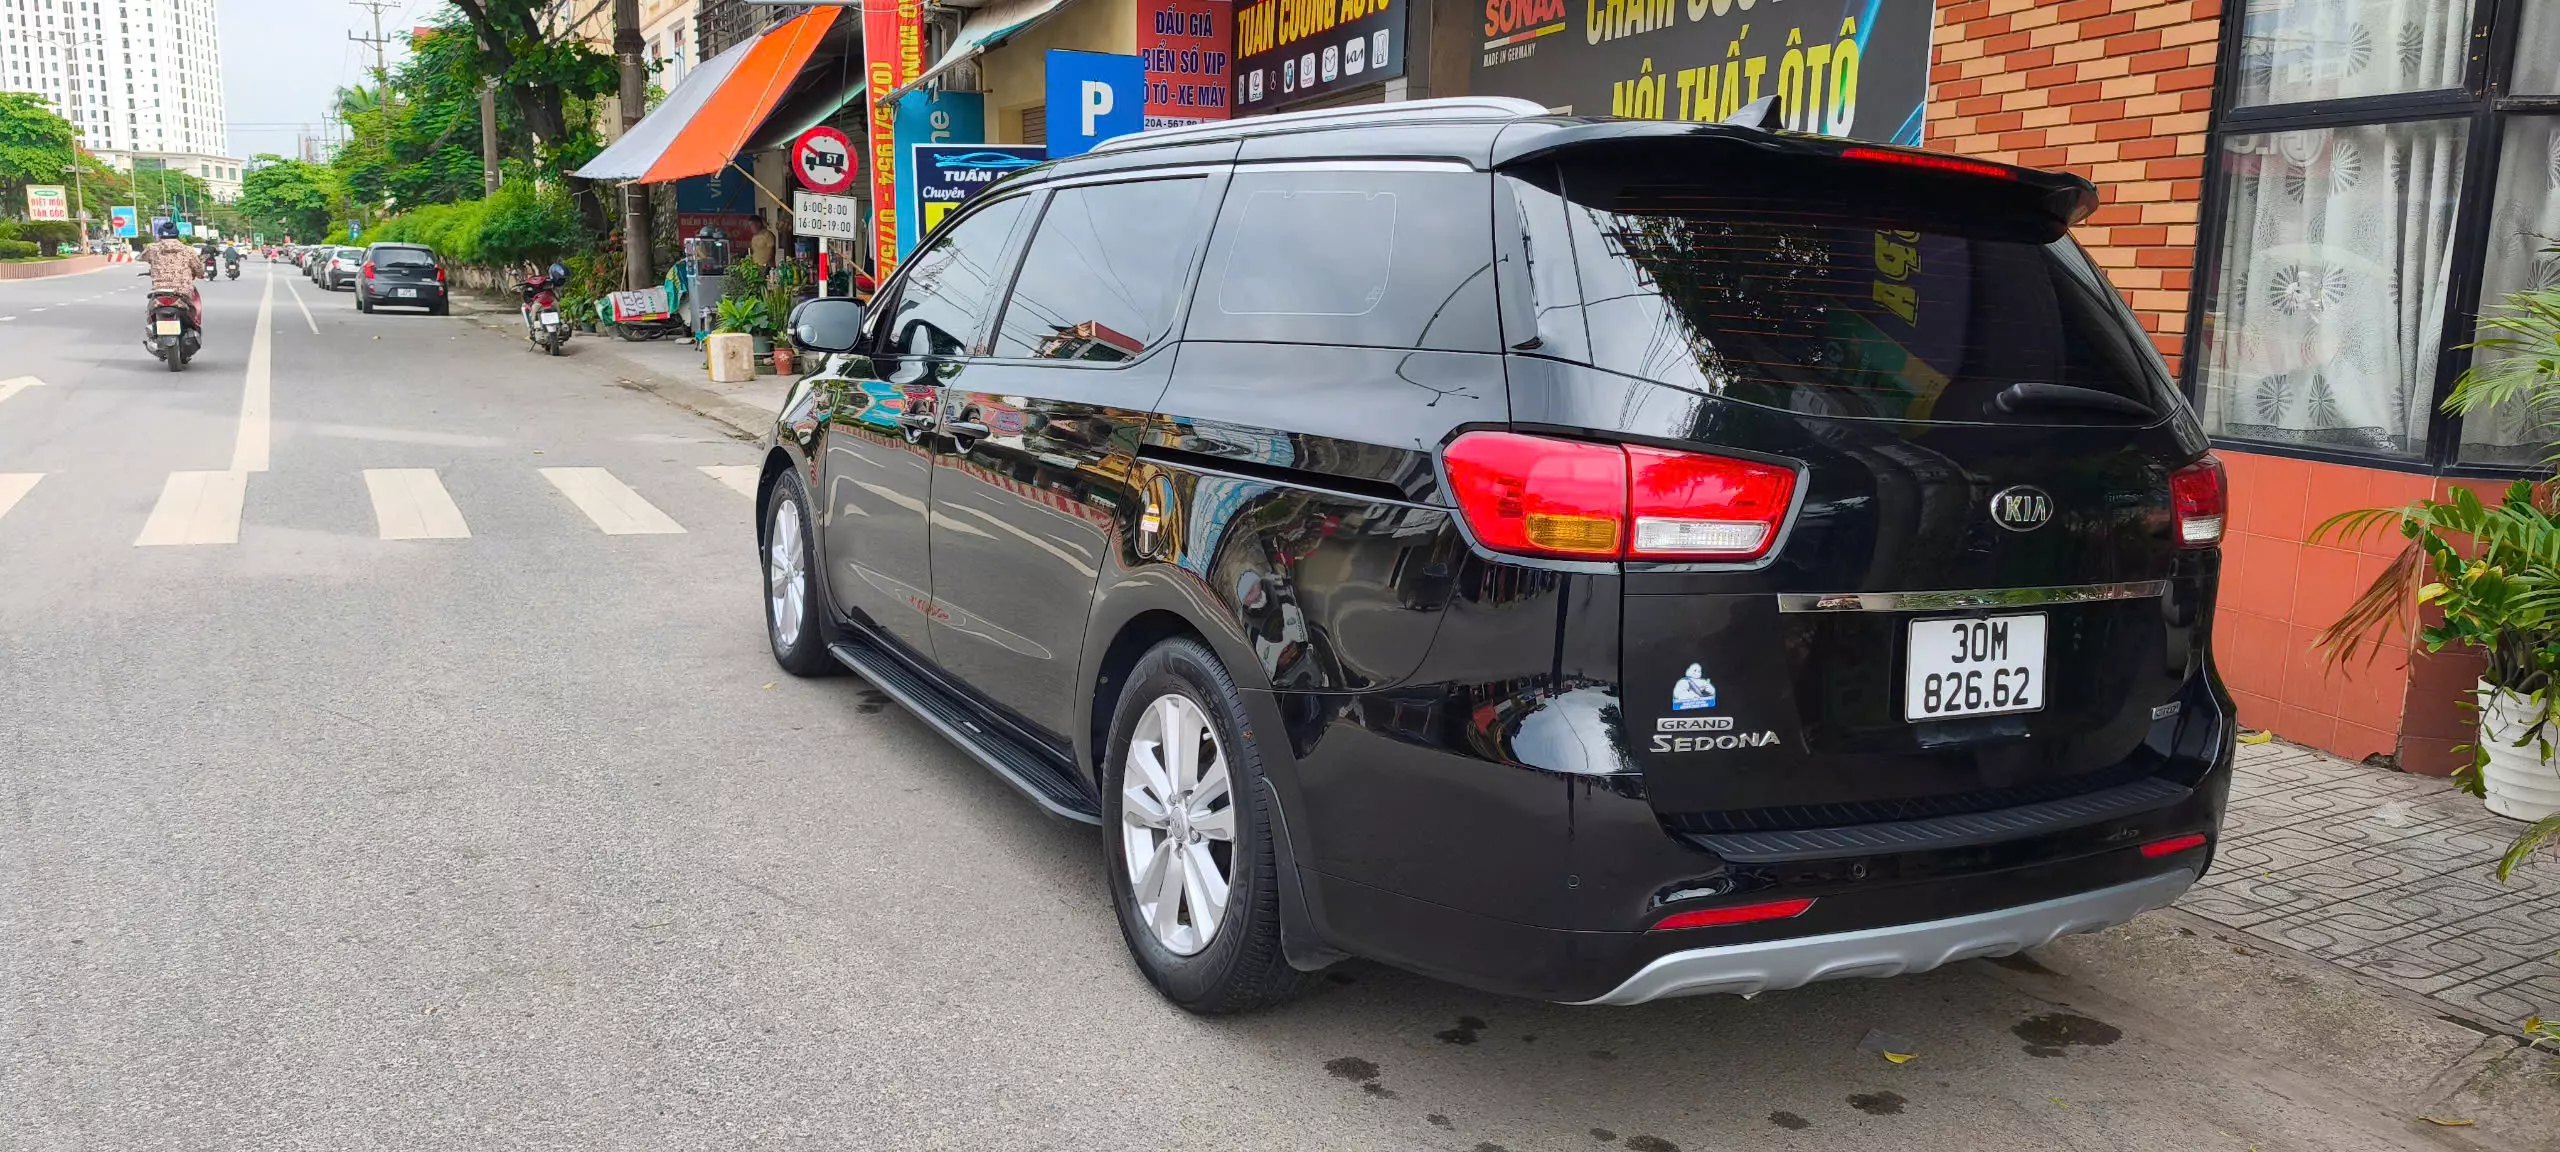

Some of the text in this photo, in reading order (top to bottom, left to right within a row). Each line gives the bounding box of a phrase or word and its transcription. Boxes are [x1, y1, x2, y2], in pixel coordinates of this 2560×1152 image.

[1155, 3, 1214, 38] ĐẤU GIÁ
[1141, 40, 1227, 75] BIỂN SỐ VIP
[1483, 42, 1536, 67] MADE IN GERMANY
[1152, 79, 1169, 105] TÔ
[1177, 84, 1194, 106] XE
[1198, 81, 1227, 107] MÁY
[1081, 80, 1114, 136] P
[826, 154, 838, 163] 5T
[944, 167, 991, 182] TUẤN
[923, 186, 965, 200] Chuyên
[803, 201, 848, 216] 6:00-8:00
[799, 217, 851, 232] 16:00-19:00
[2003, 495, 2046, 522] KIA
[1951, 621, 2009, 663] 30M
[1923, 667, 2030, 713] 826.62
[1661, 720, 1731, 730] GRAND
[1650, 731, 1781, 753] SEDONA
